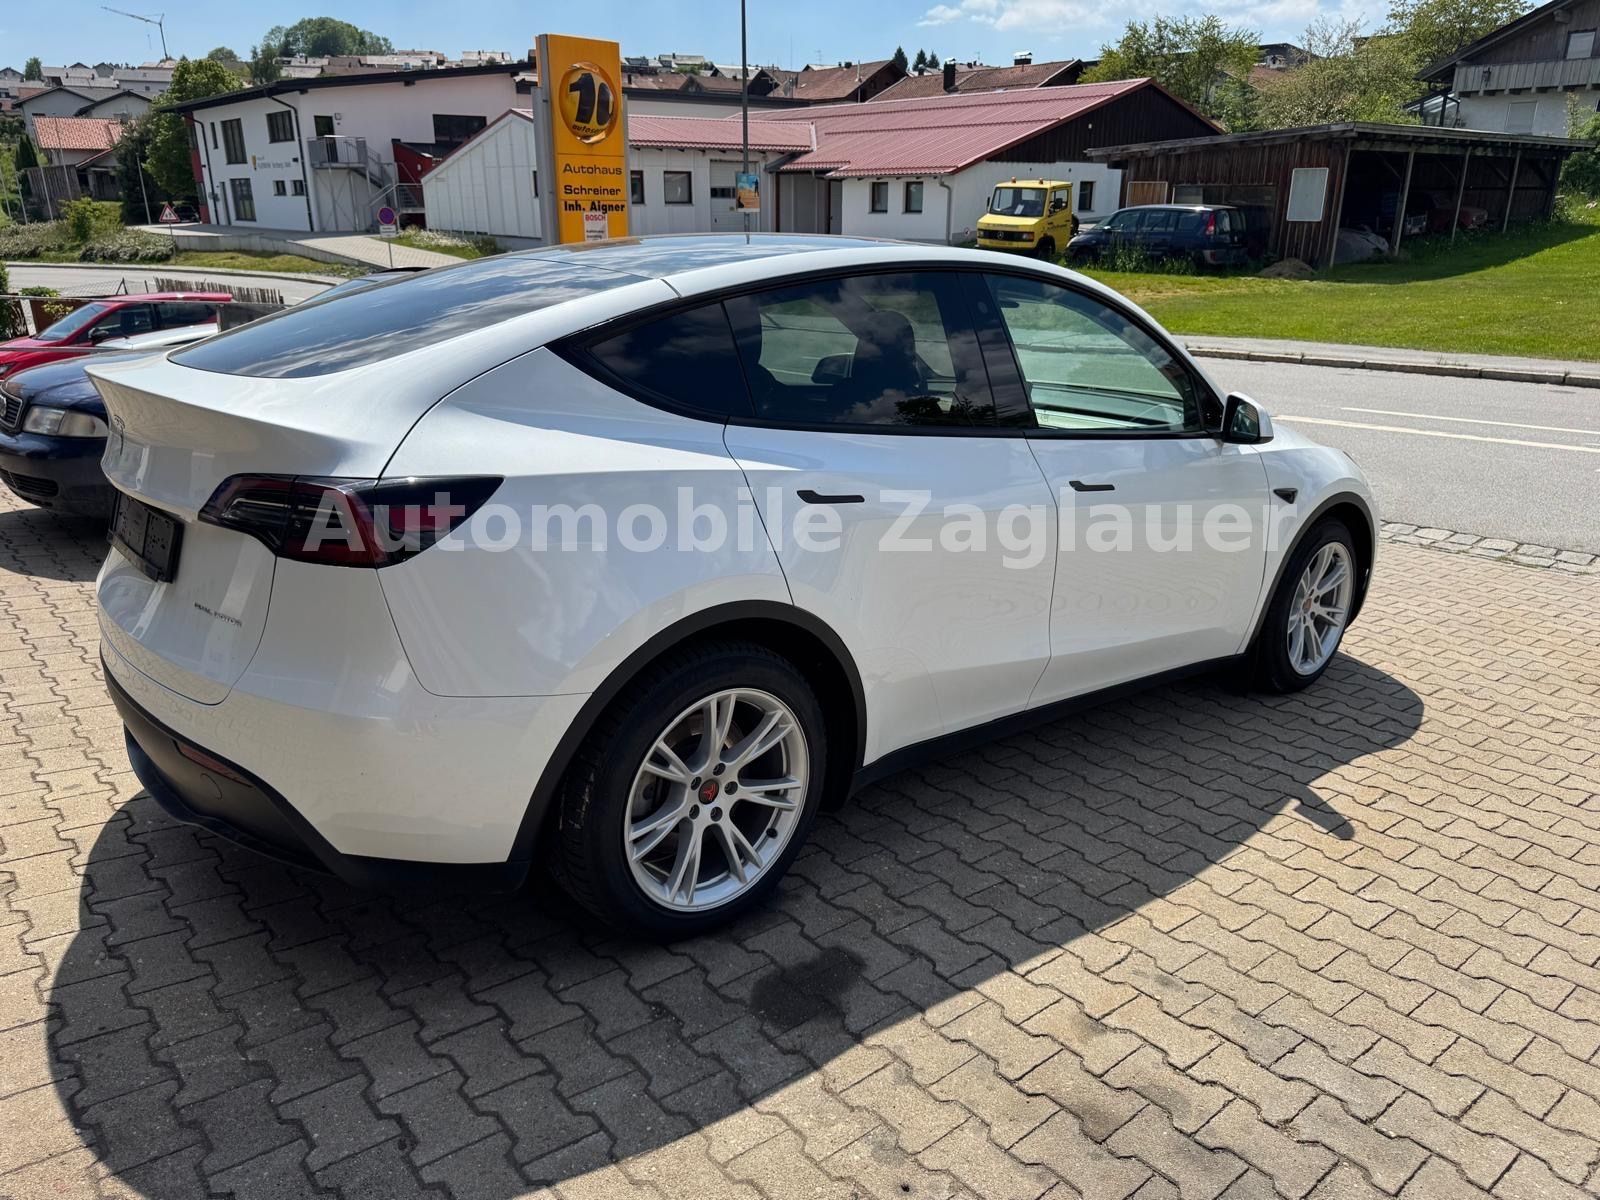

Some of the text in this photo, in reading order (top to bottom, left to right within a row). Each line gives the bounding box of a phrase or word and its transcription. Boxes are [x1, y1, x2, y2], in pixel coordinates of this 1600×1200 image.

[563, 163, 623, 176] Autohaus
[563, 184, 622, 196] Schreiner
[564, 200, 625, 214] Inh. Aigner
[585, 214, 606, 222] BOSCH
